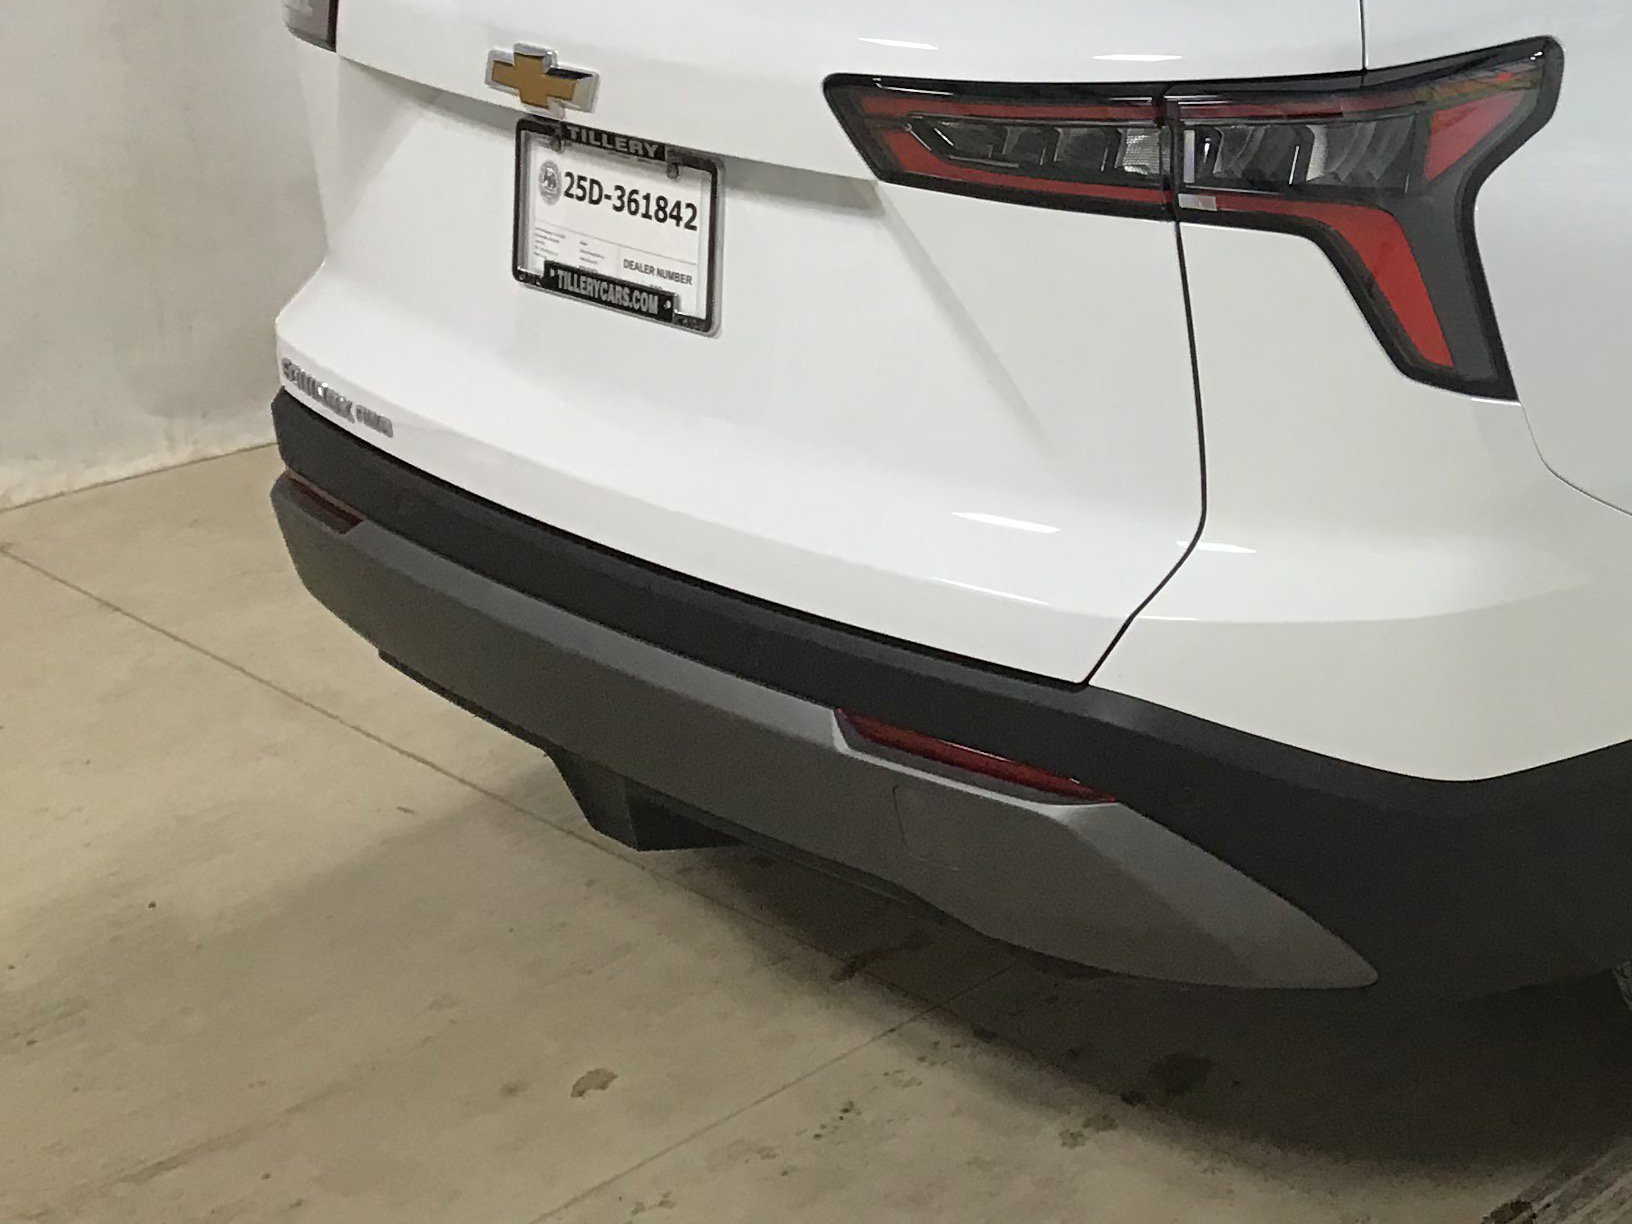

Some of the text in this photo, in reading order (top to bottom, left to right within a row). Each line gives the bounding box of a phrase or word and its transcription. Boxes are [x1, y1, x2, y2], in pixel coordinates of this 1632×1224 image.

[567, 125, 658, 157] TILLERY
[563, 171, 698, 231] 25D-361842
[557, 268, 658, 314] TILLERYCARS.COM
[623, 258, 692, 285] DEALER NUMBER
